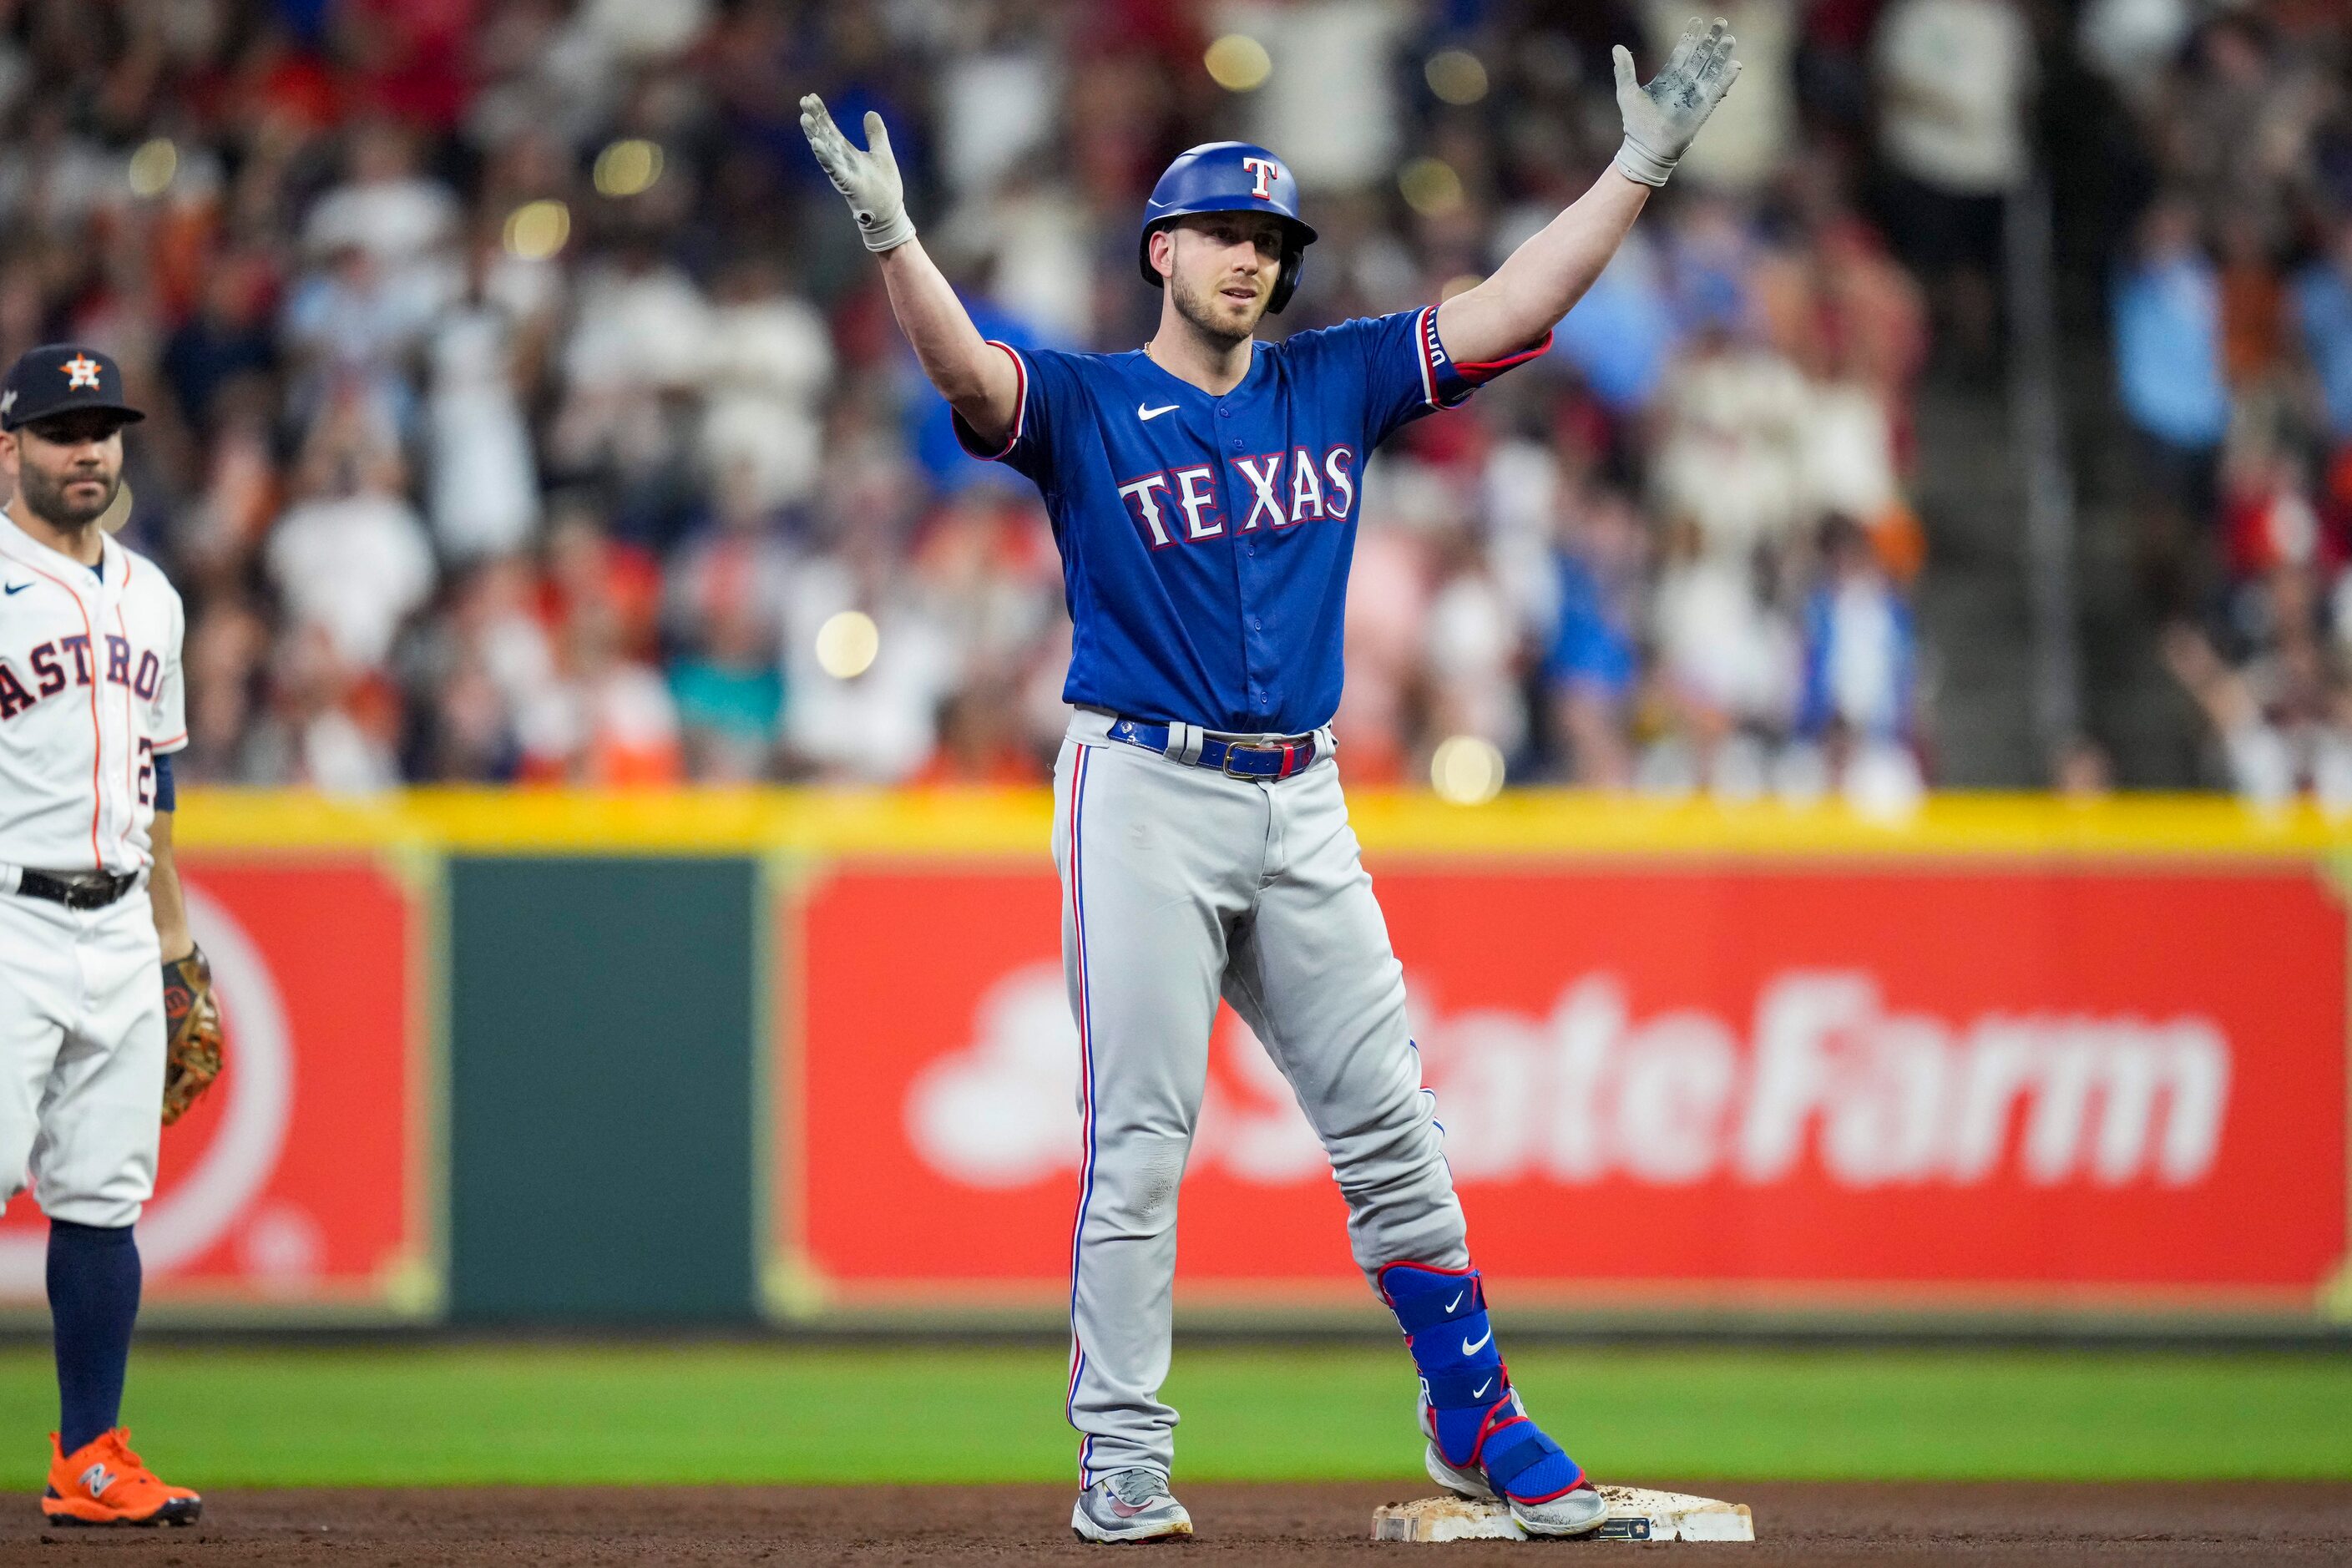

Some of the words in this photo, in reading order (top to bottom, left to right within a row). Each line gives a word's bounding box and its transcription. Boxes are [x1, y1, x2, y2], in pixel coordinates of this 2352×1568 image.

[1242, 156, 1278, 201] T
[1117, 443, 1355, 551] TEXAS
[0, 633, 165, 721] ASTRO
